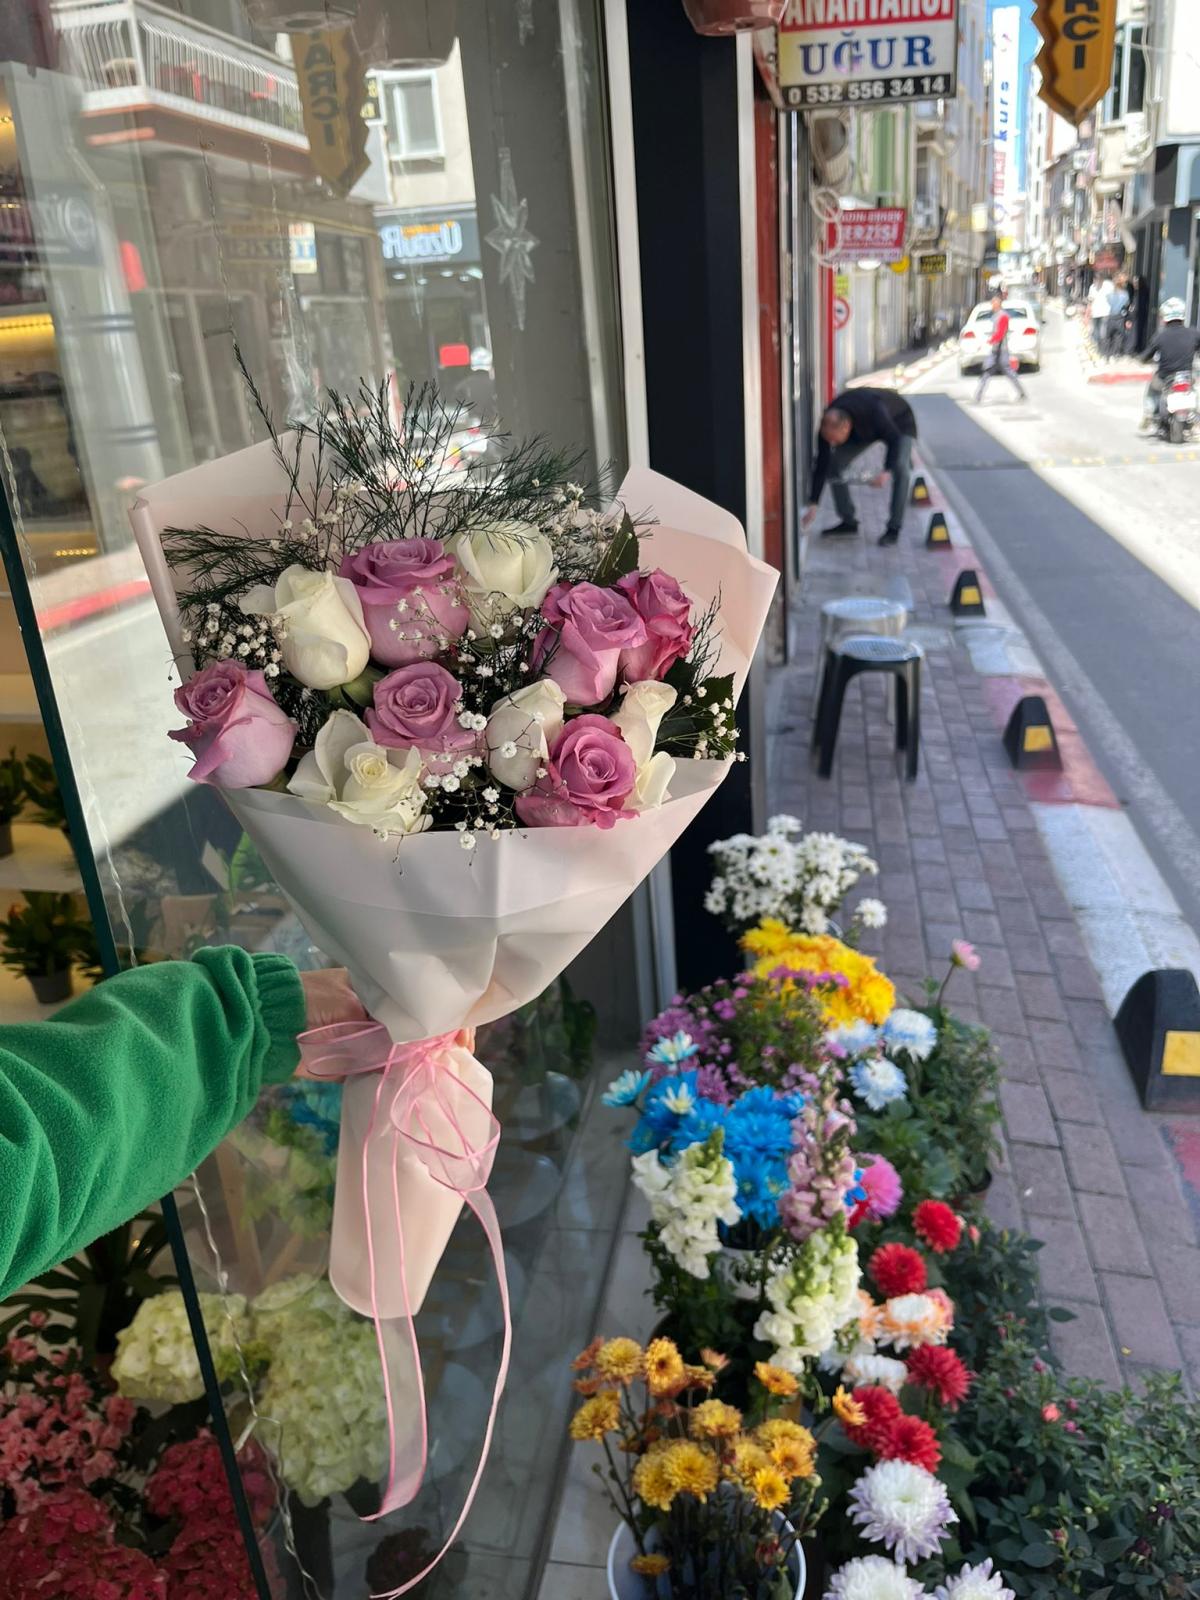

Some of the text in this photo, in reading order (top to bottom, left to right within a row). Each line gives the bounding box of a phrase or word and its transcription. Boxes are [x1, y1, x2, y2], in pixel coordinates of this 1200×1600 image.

[798, 30, 936, 75] UĞUR
[788, 76, 945, 104] 0 532 556 34 14
[994, 81, 1009, 142] kurs
